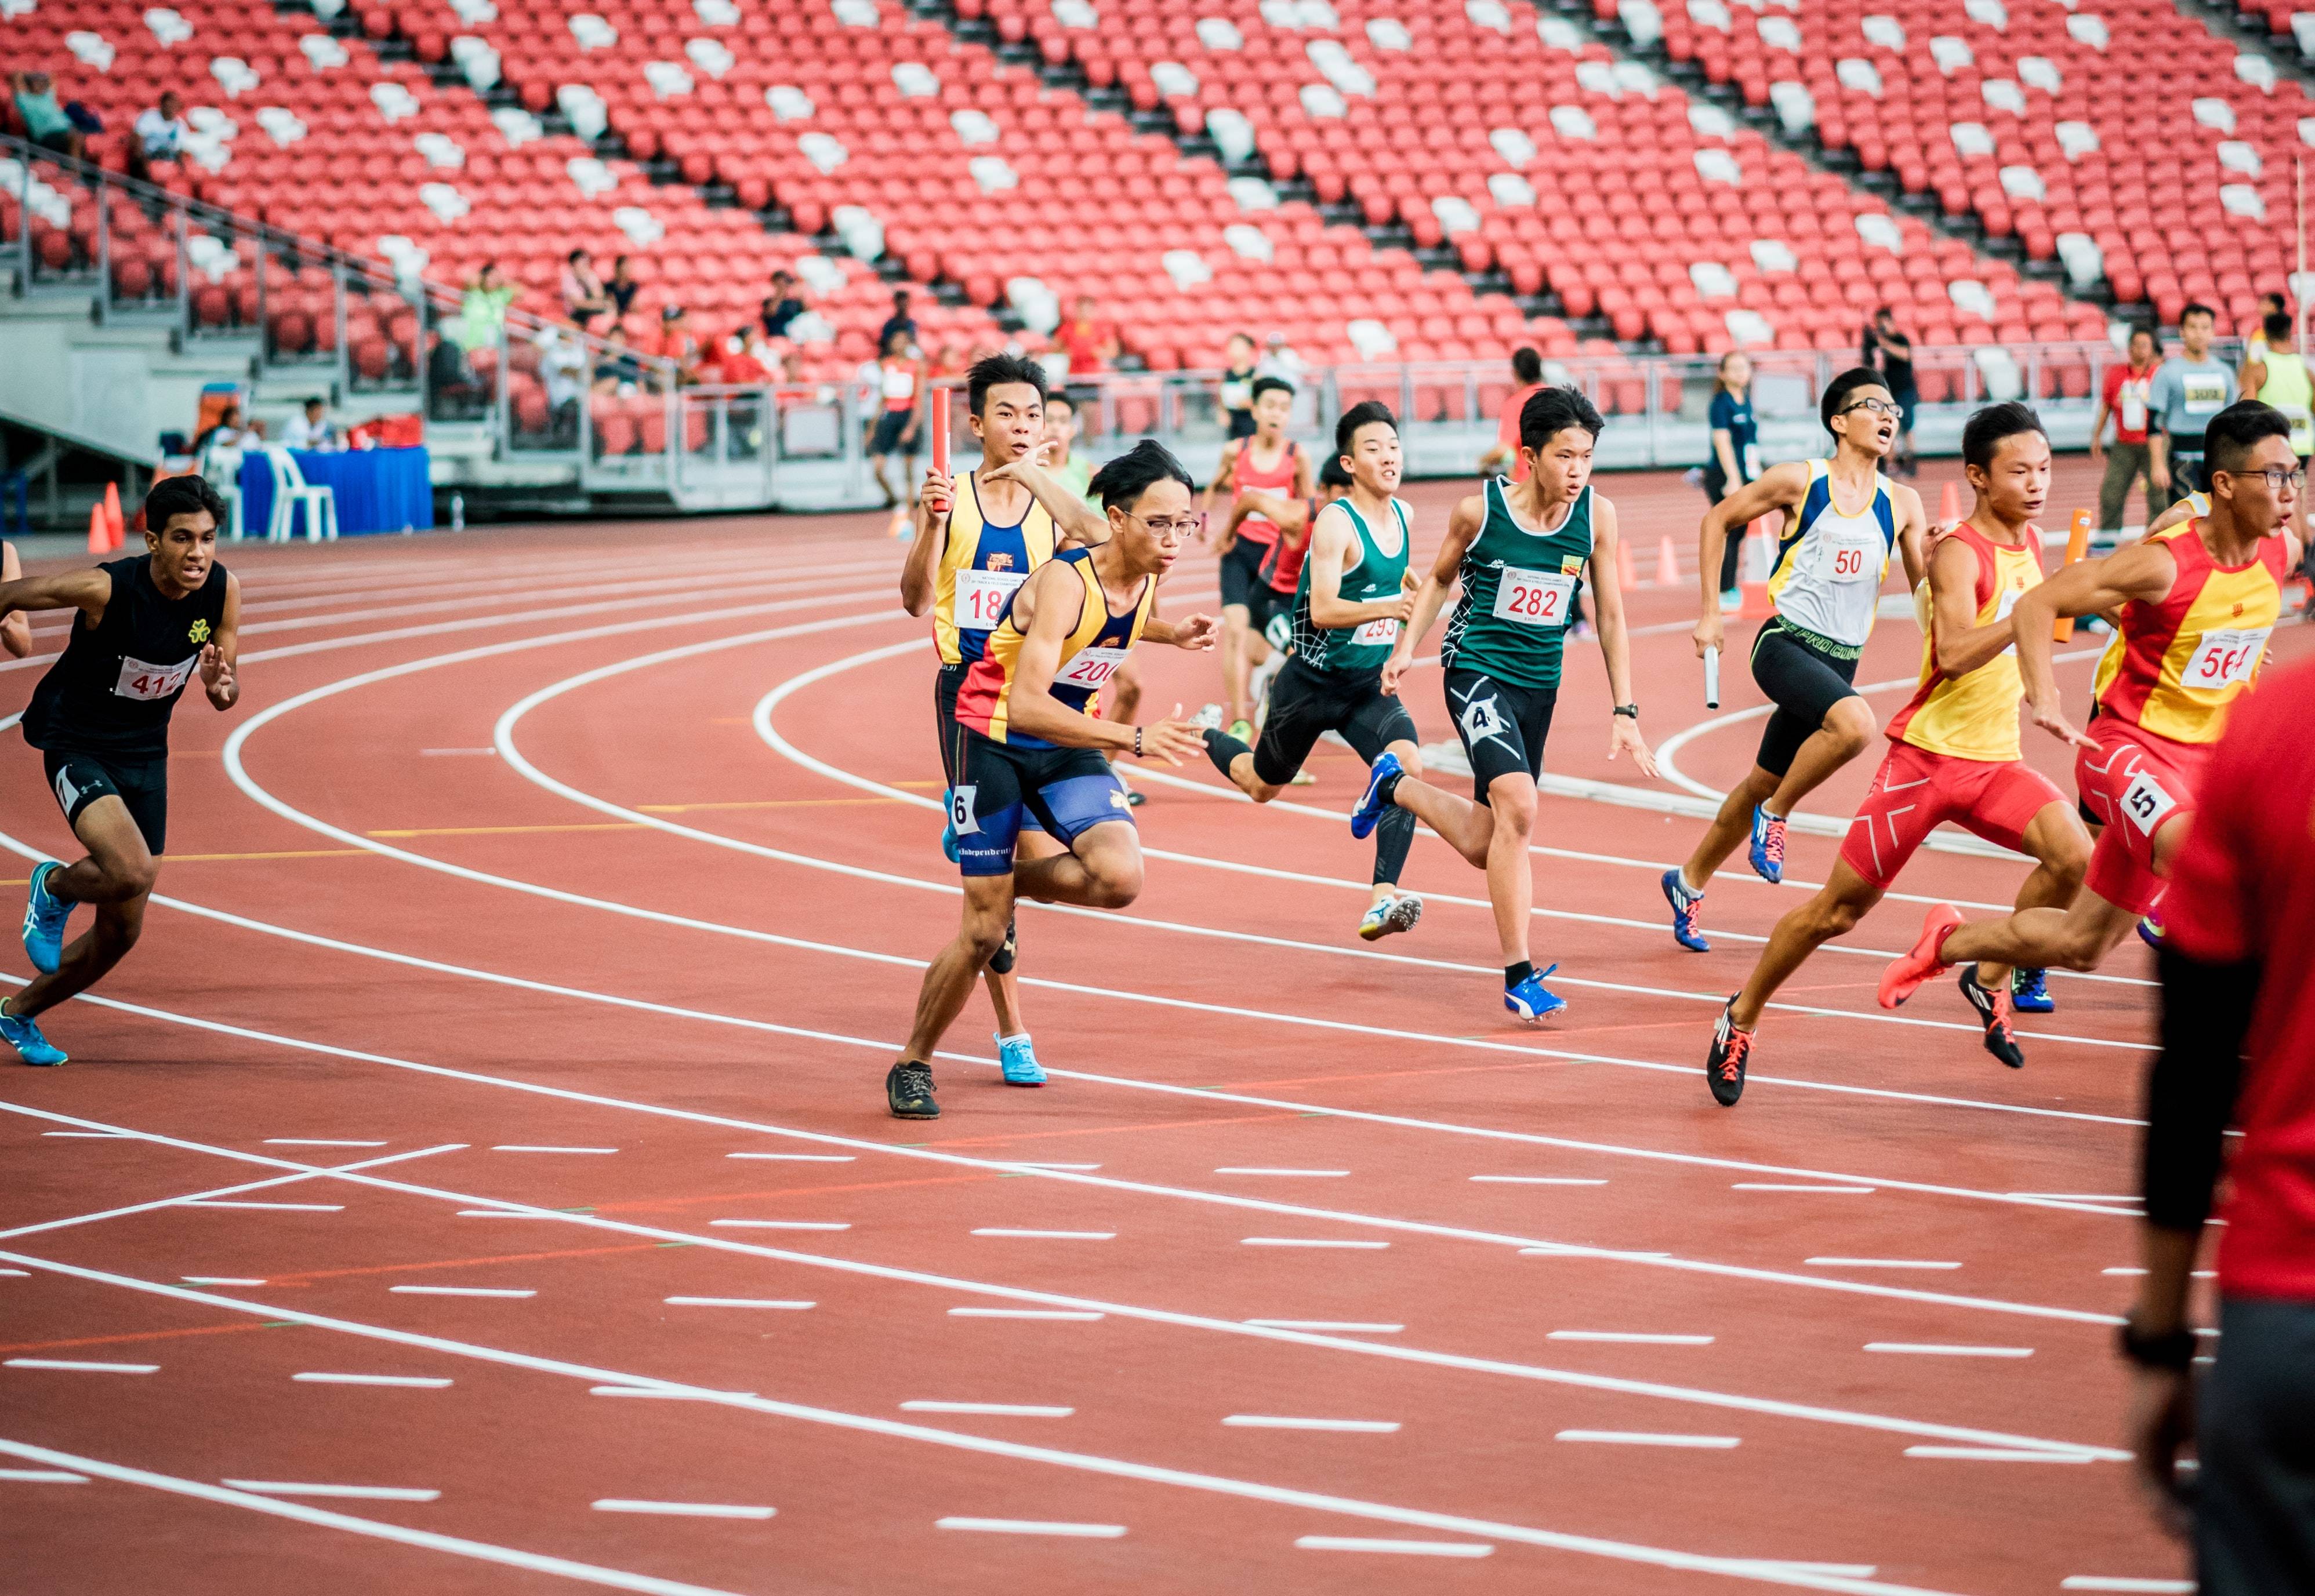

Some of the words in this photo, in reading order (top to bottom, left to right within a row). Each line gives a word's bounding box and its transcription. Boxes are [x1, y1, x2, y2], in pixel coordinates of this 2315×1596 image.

[1835, 550, 1862, 574] 50
[970, 589, 1002, 620] 18
[1508, 586, 1558, 617] 282
[1365, 618, 1395, 637] 293
[2201, 645, 2251, 679] 564
[132, 672, 182, 694] 412
[1472, 706, 1490, 729] 4
[955, 795, 967, 824] 6
[2130, 786, 2156, 818] 5
